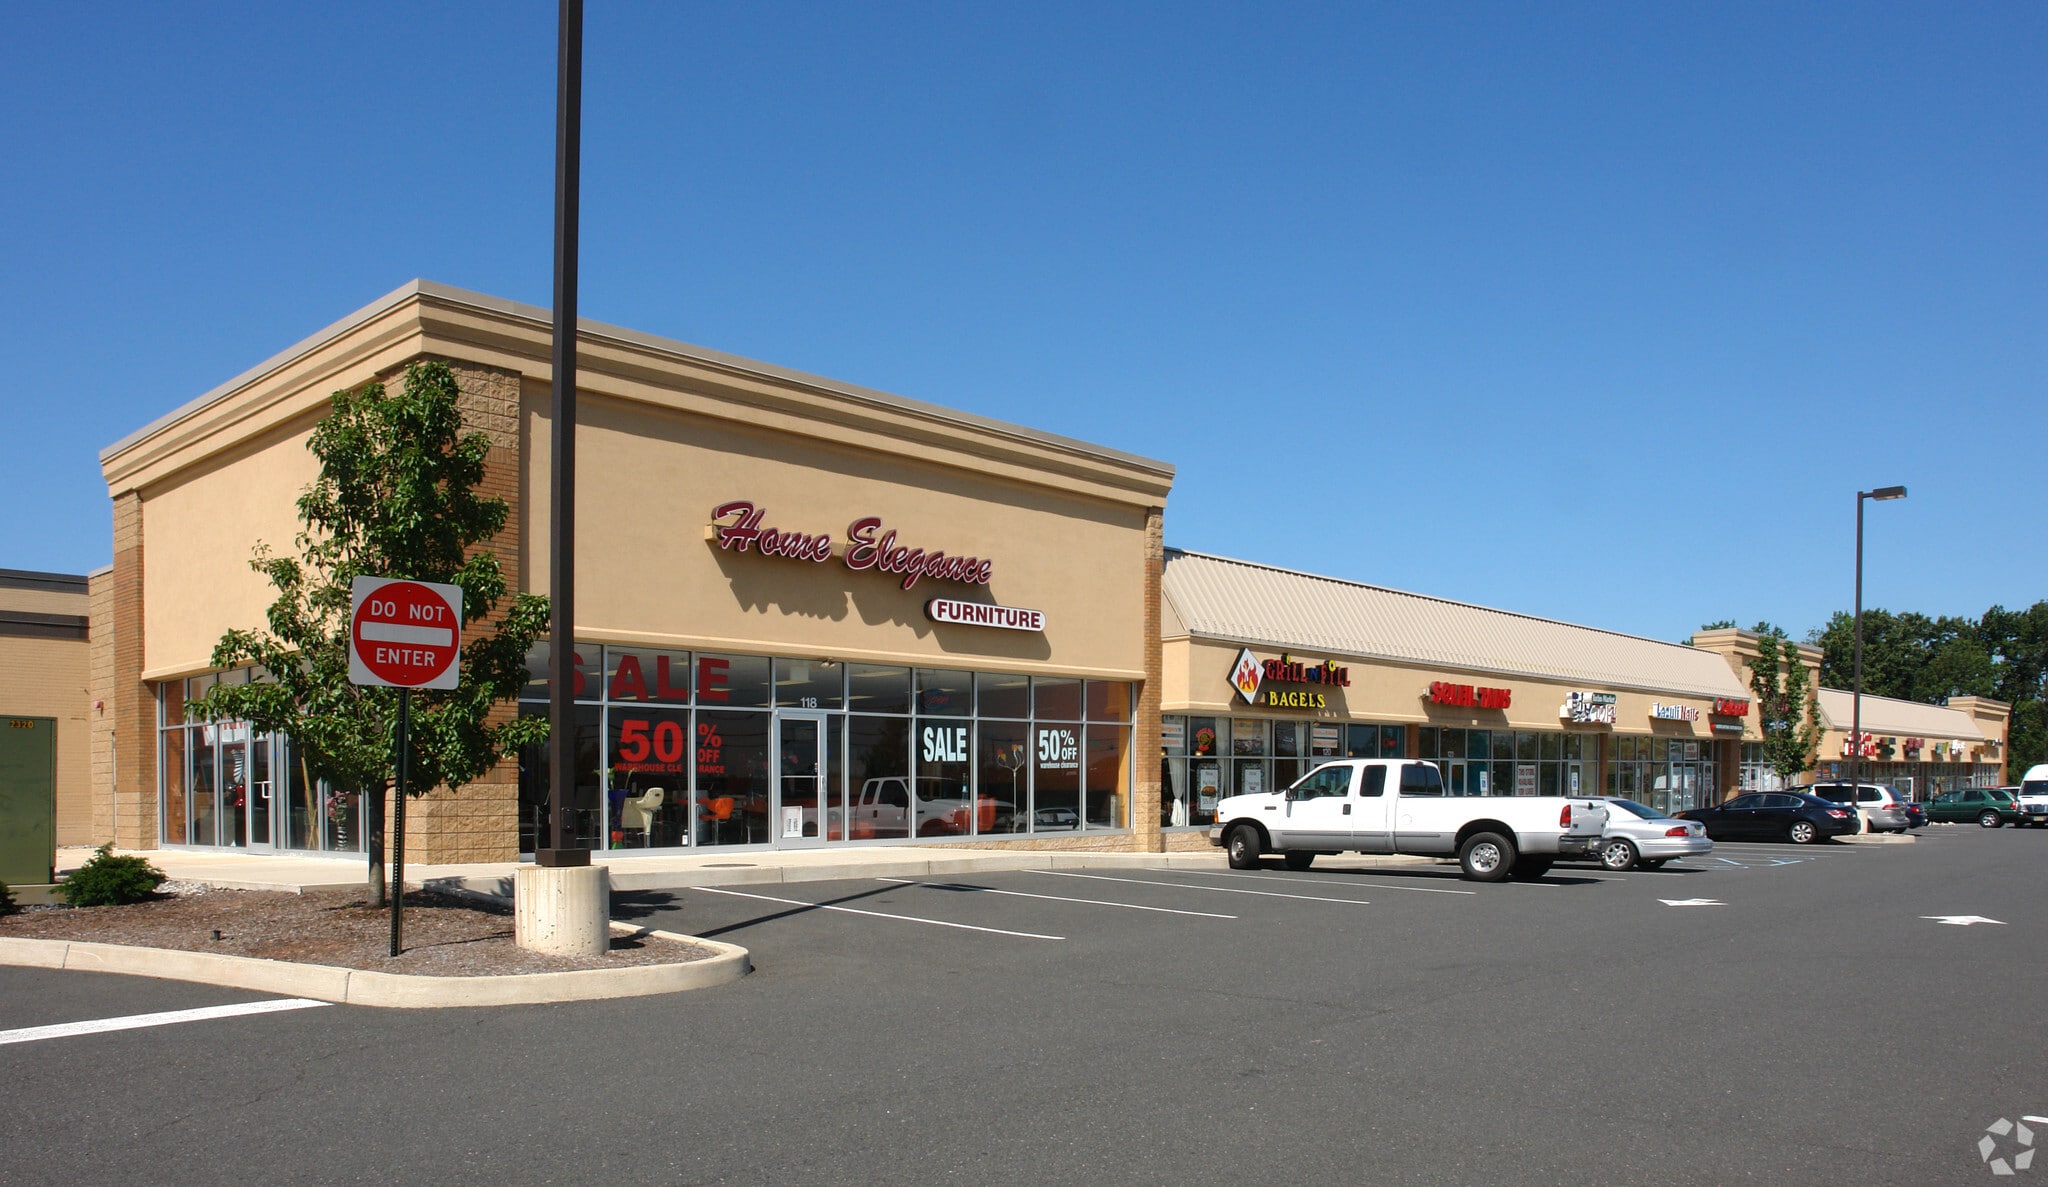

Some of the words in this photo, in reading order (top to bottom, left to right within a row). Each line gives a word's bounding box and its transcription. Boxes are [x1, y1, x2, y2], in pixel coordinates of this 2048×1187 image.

[712, 501, 832, 563] Home
[843, 517, 993, 590] Elegance
[371, 600, 396, 617] DO
[409, 604, 445, 622] NOT
[936, 601, 1042, 629] FURNITURE
[376, 648, 435, 667] ENTER
[800, 697, 817, 709] 118
[1269, 691, 1326, 708] BAGELS
[923, 726, 967, 762] SALE
[1061, 747, 1078, 760] OFF
[697, 749, 720, 763] OFF
